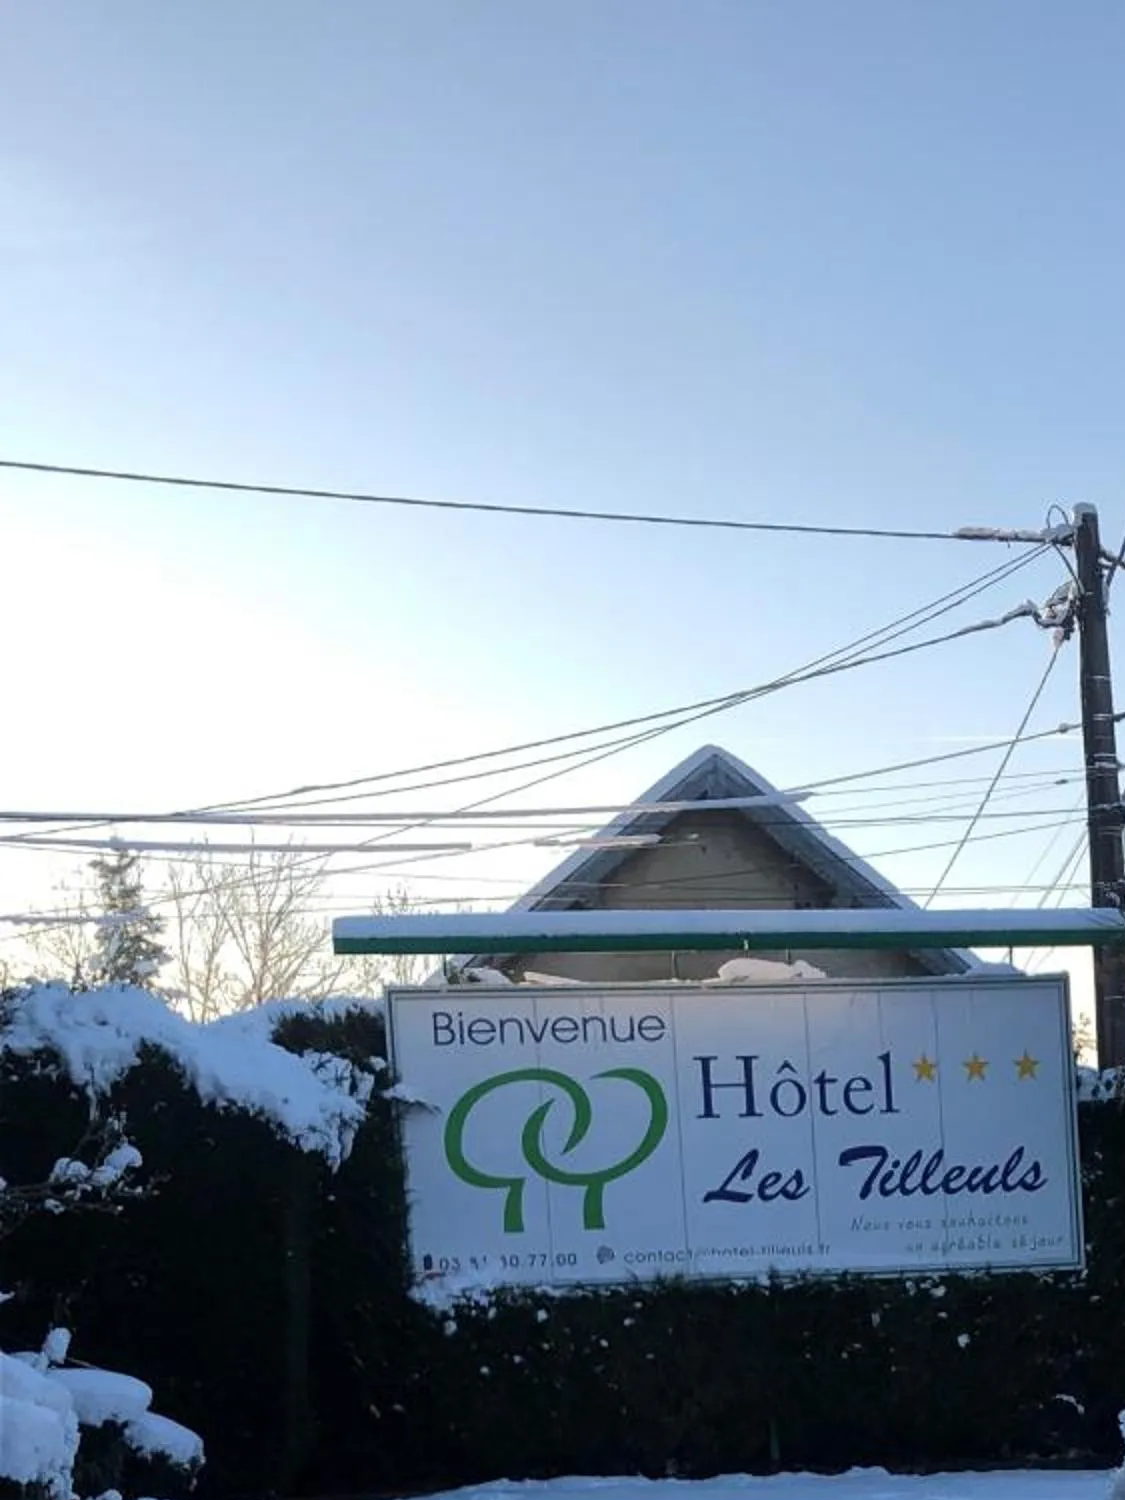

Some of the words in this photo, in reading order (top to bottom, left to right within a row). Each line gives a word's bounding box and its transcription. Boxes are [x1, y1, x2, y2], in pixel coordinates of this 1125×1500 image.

[432, 1012, 666, 1046] Bienvenue
[692, 1050, 901, 1119] Hôtel
[703, 1148, 810, 1203] Les
[838, 1145, 1048, 1201] Tilleuls
[850, 1213, 889, 1232] Nous
[898, 1216, 932, 1231] vous
